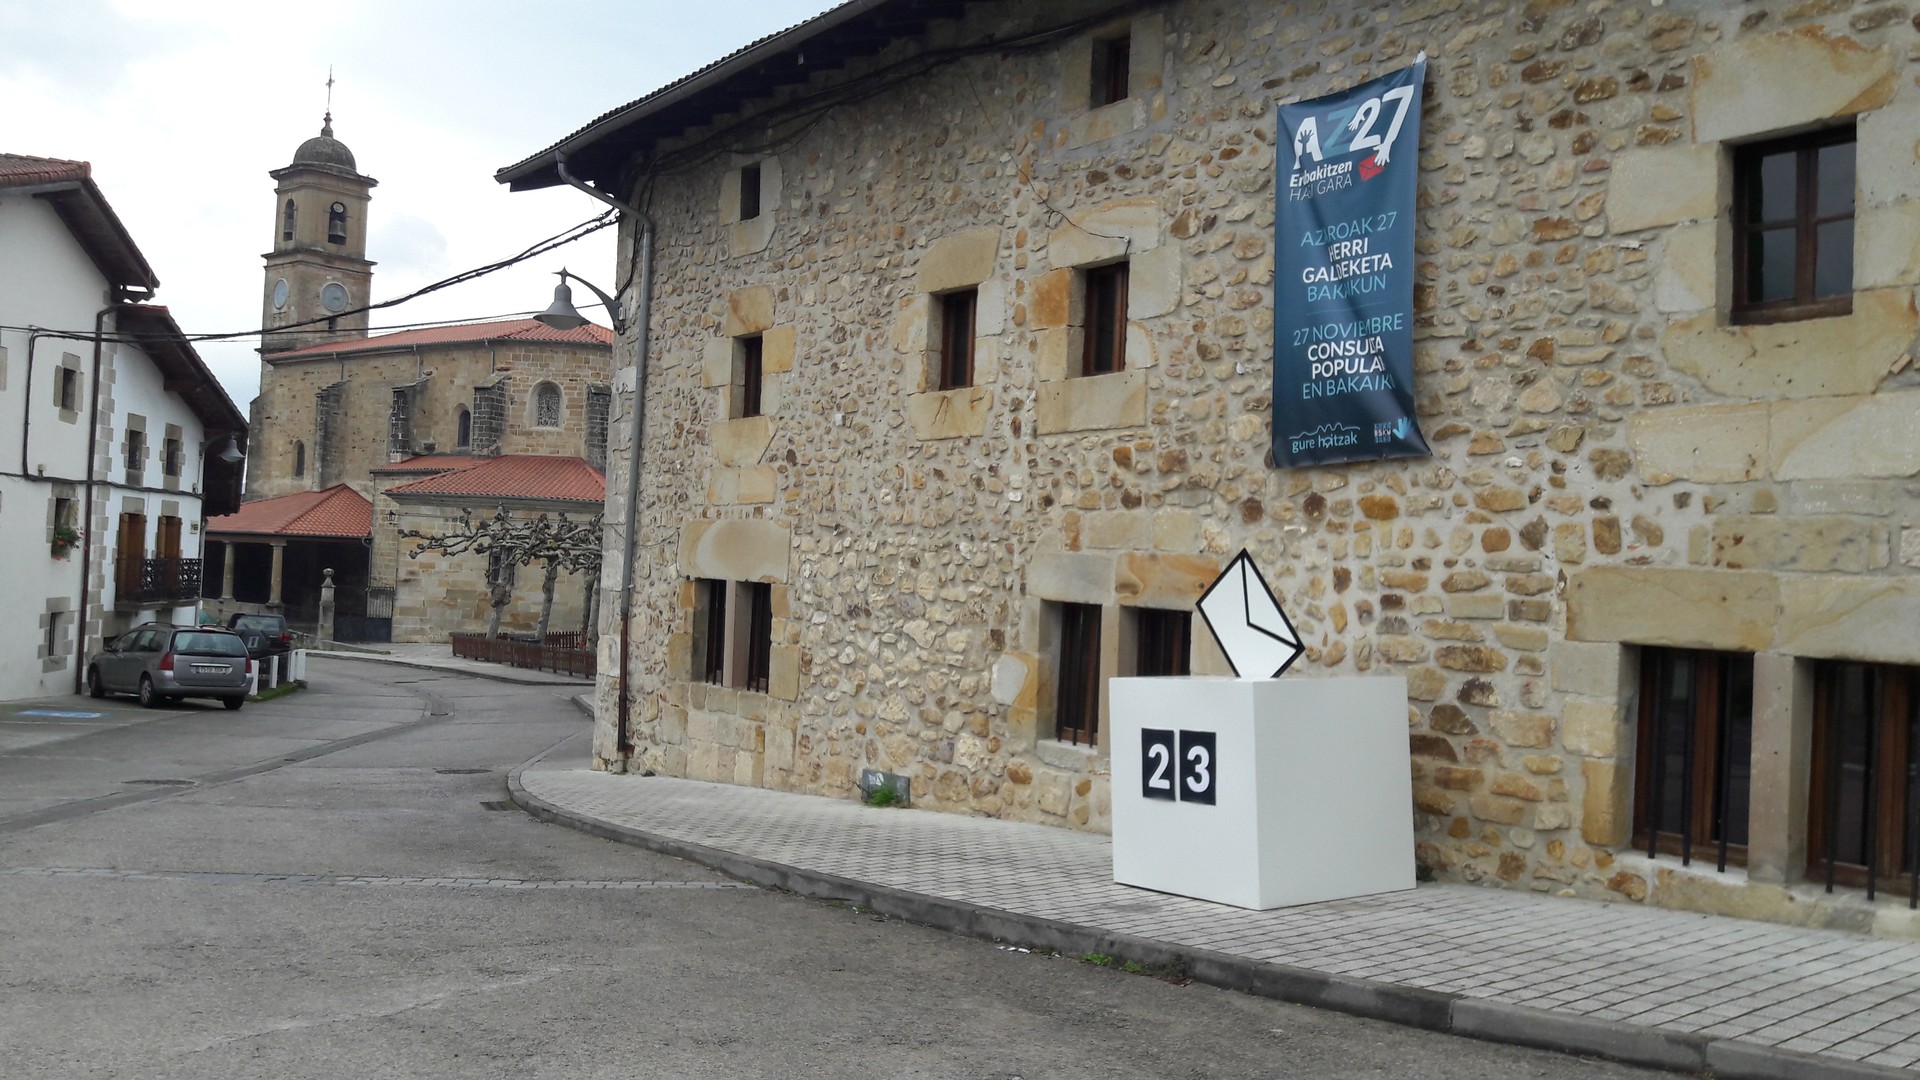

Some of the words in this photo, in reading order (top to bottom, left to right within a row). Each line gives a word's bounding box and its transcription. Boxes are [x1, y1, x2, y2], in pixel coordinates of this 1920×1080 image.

[1317, 174, 1353, 195] GARA
[1377, 211, 1398, 231] 27
[1328, 237, 1369, 262] HERRI
[1302, 252, 1393, 284] GALDEKETA
[1293, 328, 1309, 346] 27
[1313, 313, 1404, 342] NOVIEMBRE
[1307, 335, 1384, 361] CONSULTA
[1302, 381, 1322, 399] EN
[1326, 374, 1395, 396] BAKAIK
[1292, 439, 1315, 453] gure
